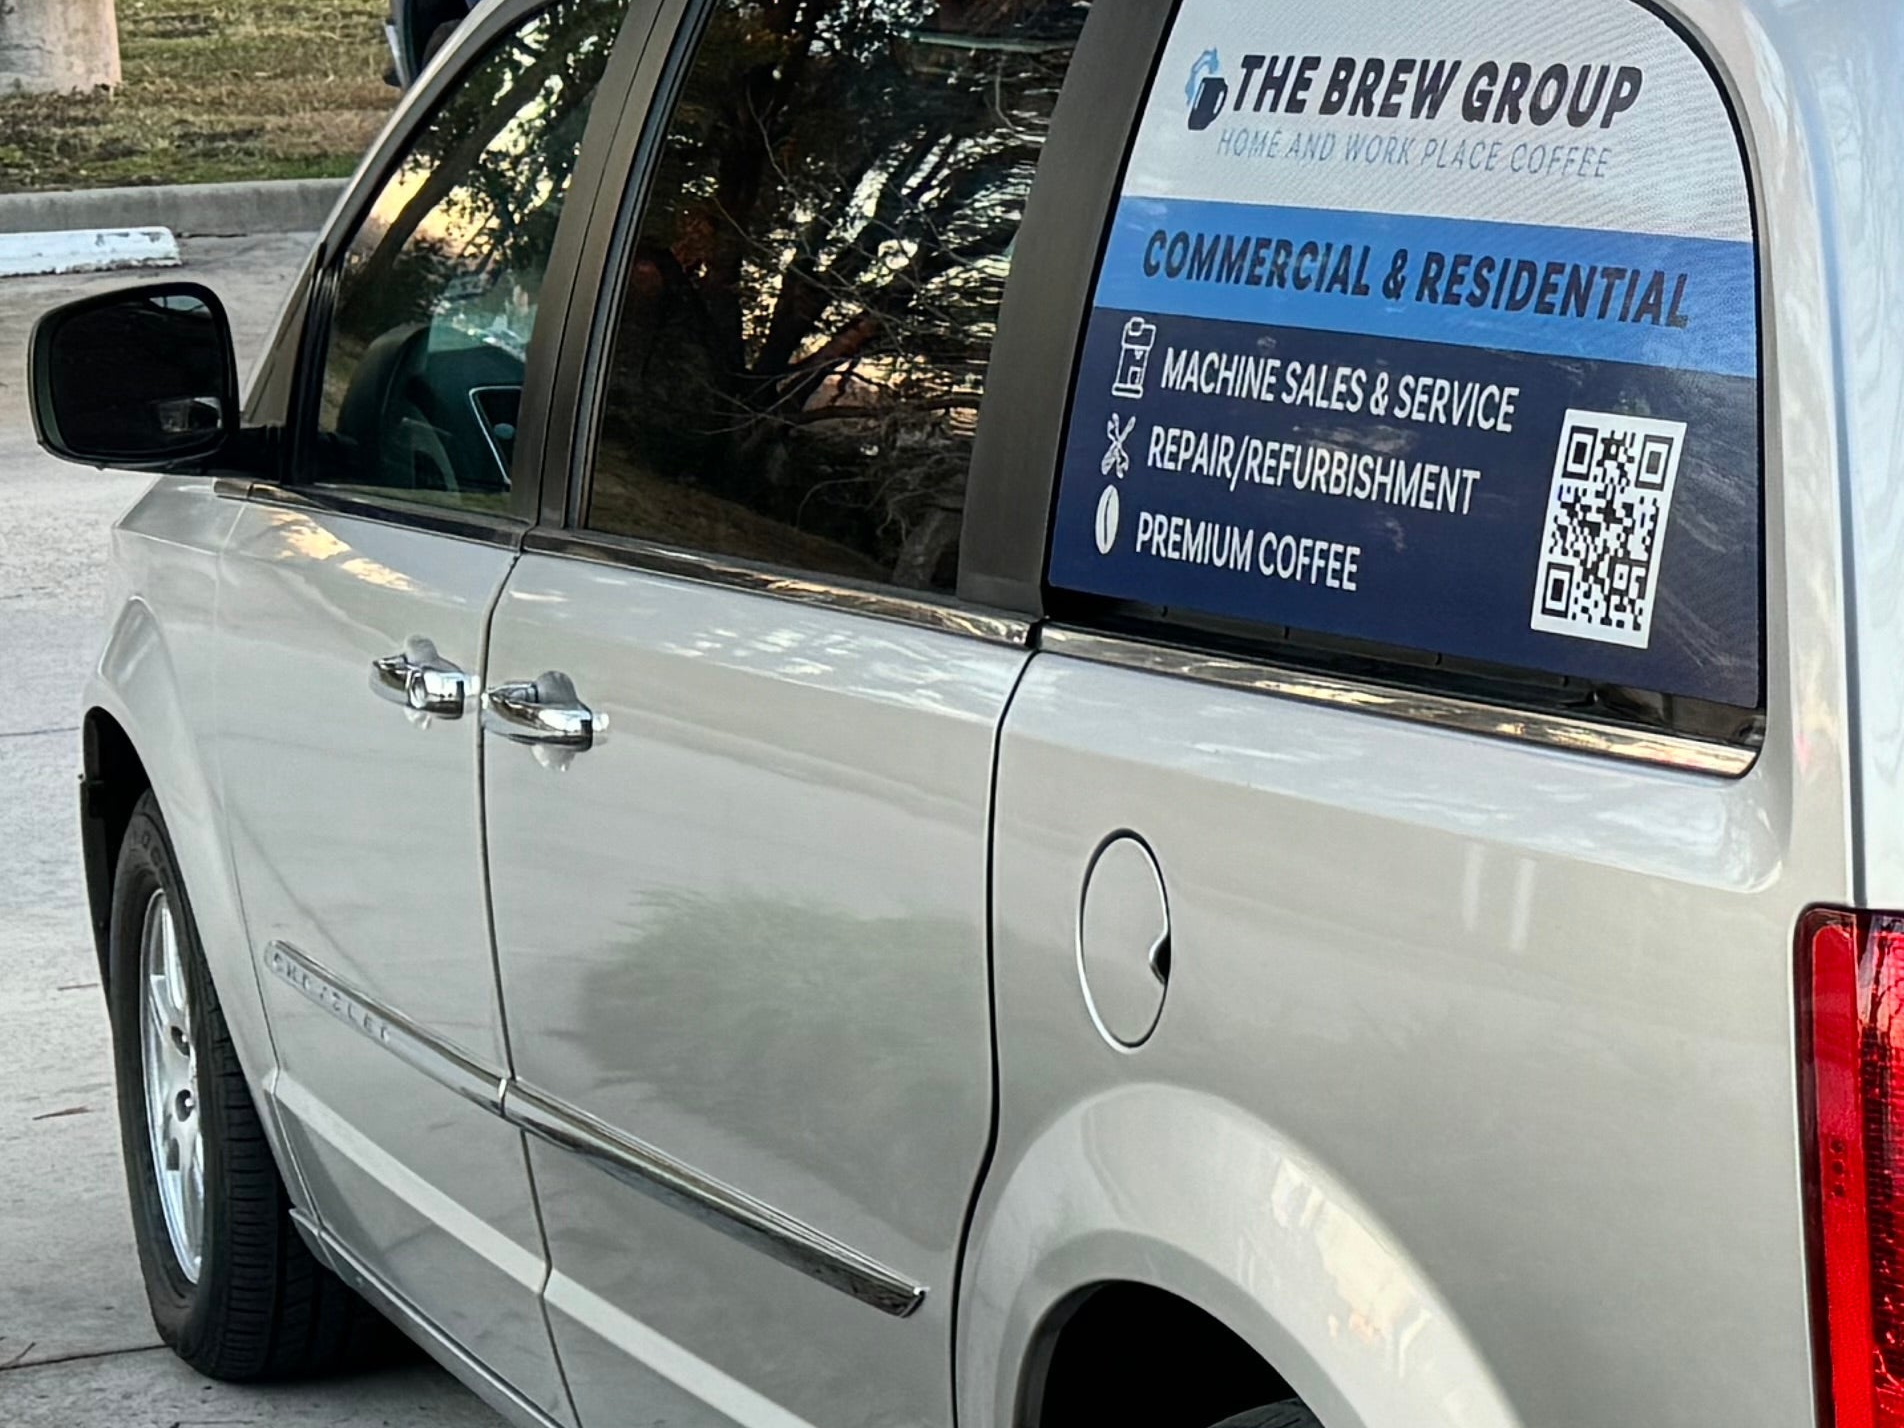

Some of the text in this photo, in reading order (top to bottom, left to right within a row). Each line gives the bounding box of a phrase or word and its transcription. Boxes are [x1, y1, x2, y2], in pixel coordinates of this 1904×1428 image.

[1233, 54, 1643, 129] THE BREW GROUP
[1217, 128, 1612, 178] HOME AND WORK PLACE COFFEE
[1143, 228, 1688, 328] COMMERCIAL & RESIDENTIAL
[1161, 347, 1520, 433] MACHINE SALES & SERVICE
[1147, 425, 1481, 515] REPAIR/REFURBISHMENT
[1135, 511, 1361, 591] PREMIUM COFFEE
